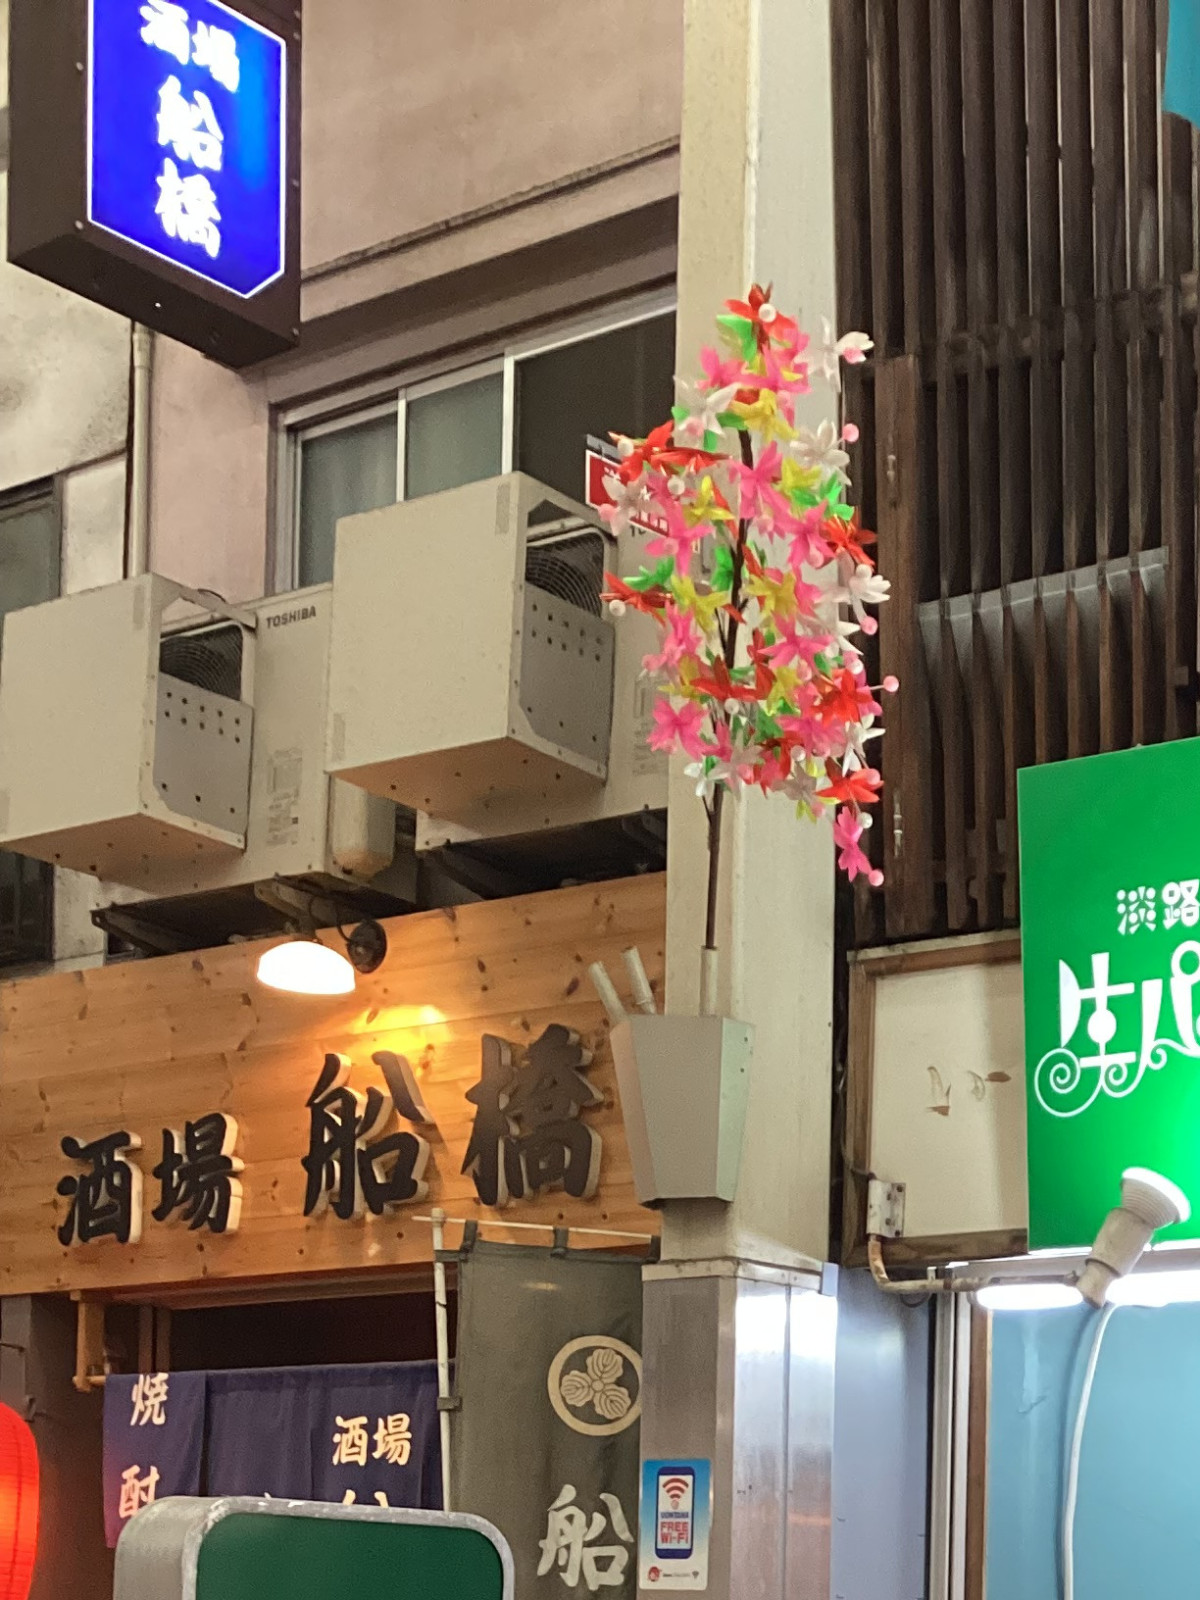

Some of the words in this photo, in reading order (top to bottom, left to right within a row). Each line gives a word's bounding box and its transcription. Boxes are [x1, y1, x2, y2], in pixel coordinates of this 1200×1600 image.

[154, 74, 224, 258] 船橋
[266, 605, 317, 629] TOSHIBA
[57, 1112, 245, 1246] 酒場
[302, 1023, 604, 1220] 船橋
[117, 1372, 169, 1519] 焼酎
[332, 1413, 412, 1466] 酒場
[660, 1522, 689, 1532] FREE
